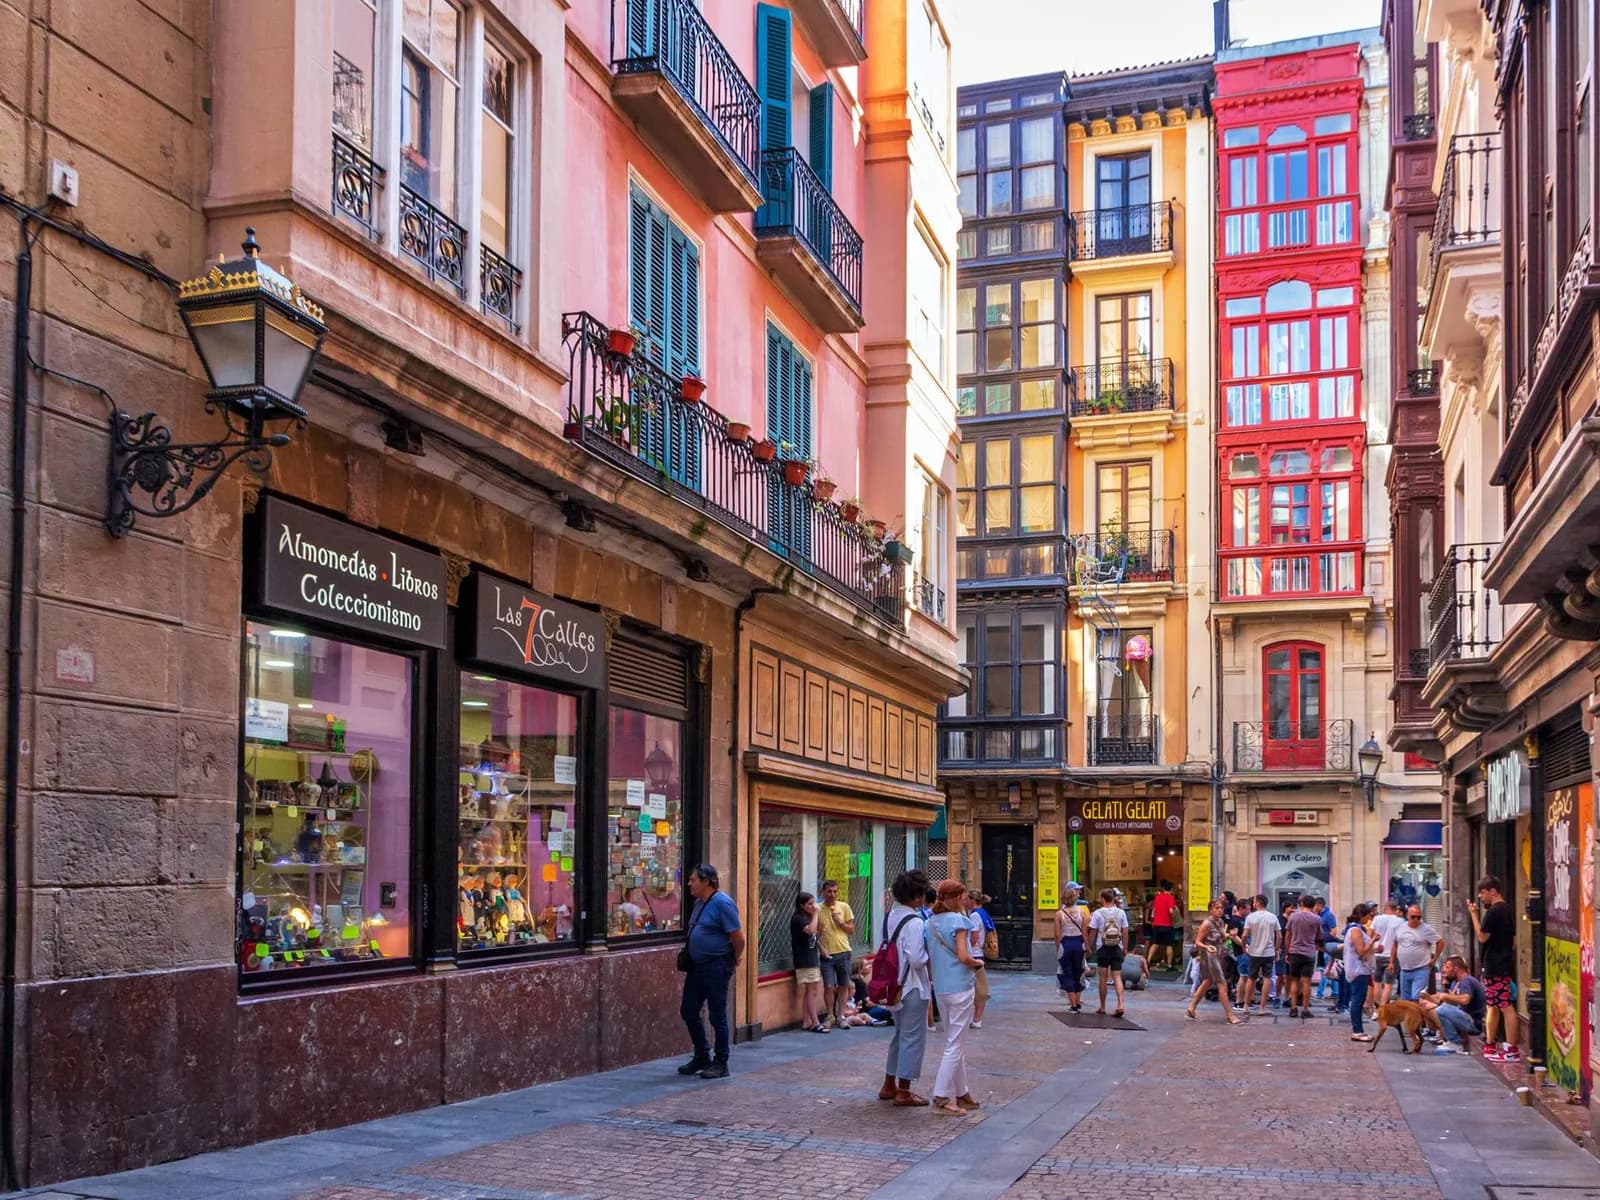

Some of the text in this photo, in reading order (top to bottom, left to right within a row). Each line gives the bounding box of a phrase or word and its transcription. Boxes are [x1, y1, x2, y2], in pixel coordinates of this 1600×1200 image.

[279, 523, 438, 600] Almonedas Libros
[301, 573, 421, 631] Coleccionismo
[495, 586, 595, 664] Las 7 Calles
[1082, 801, 1166, 819] GELATI GELATI
[1270, 854, 1322, 863] ATM Cajero
